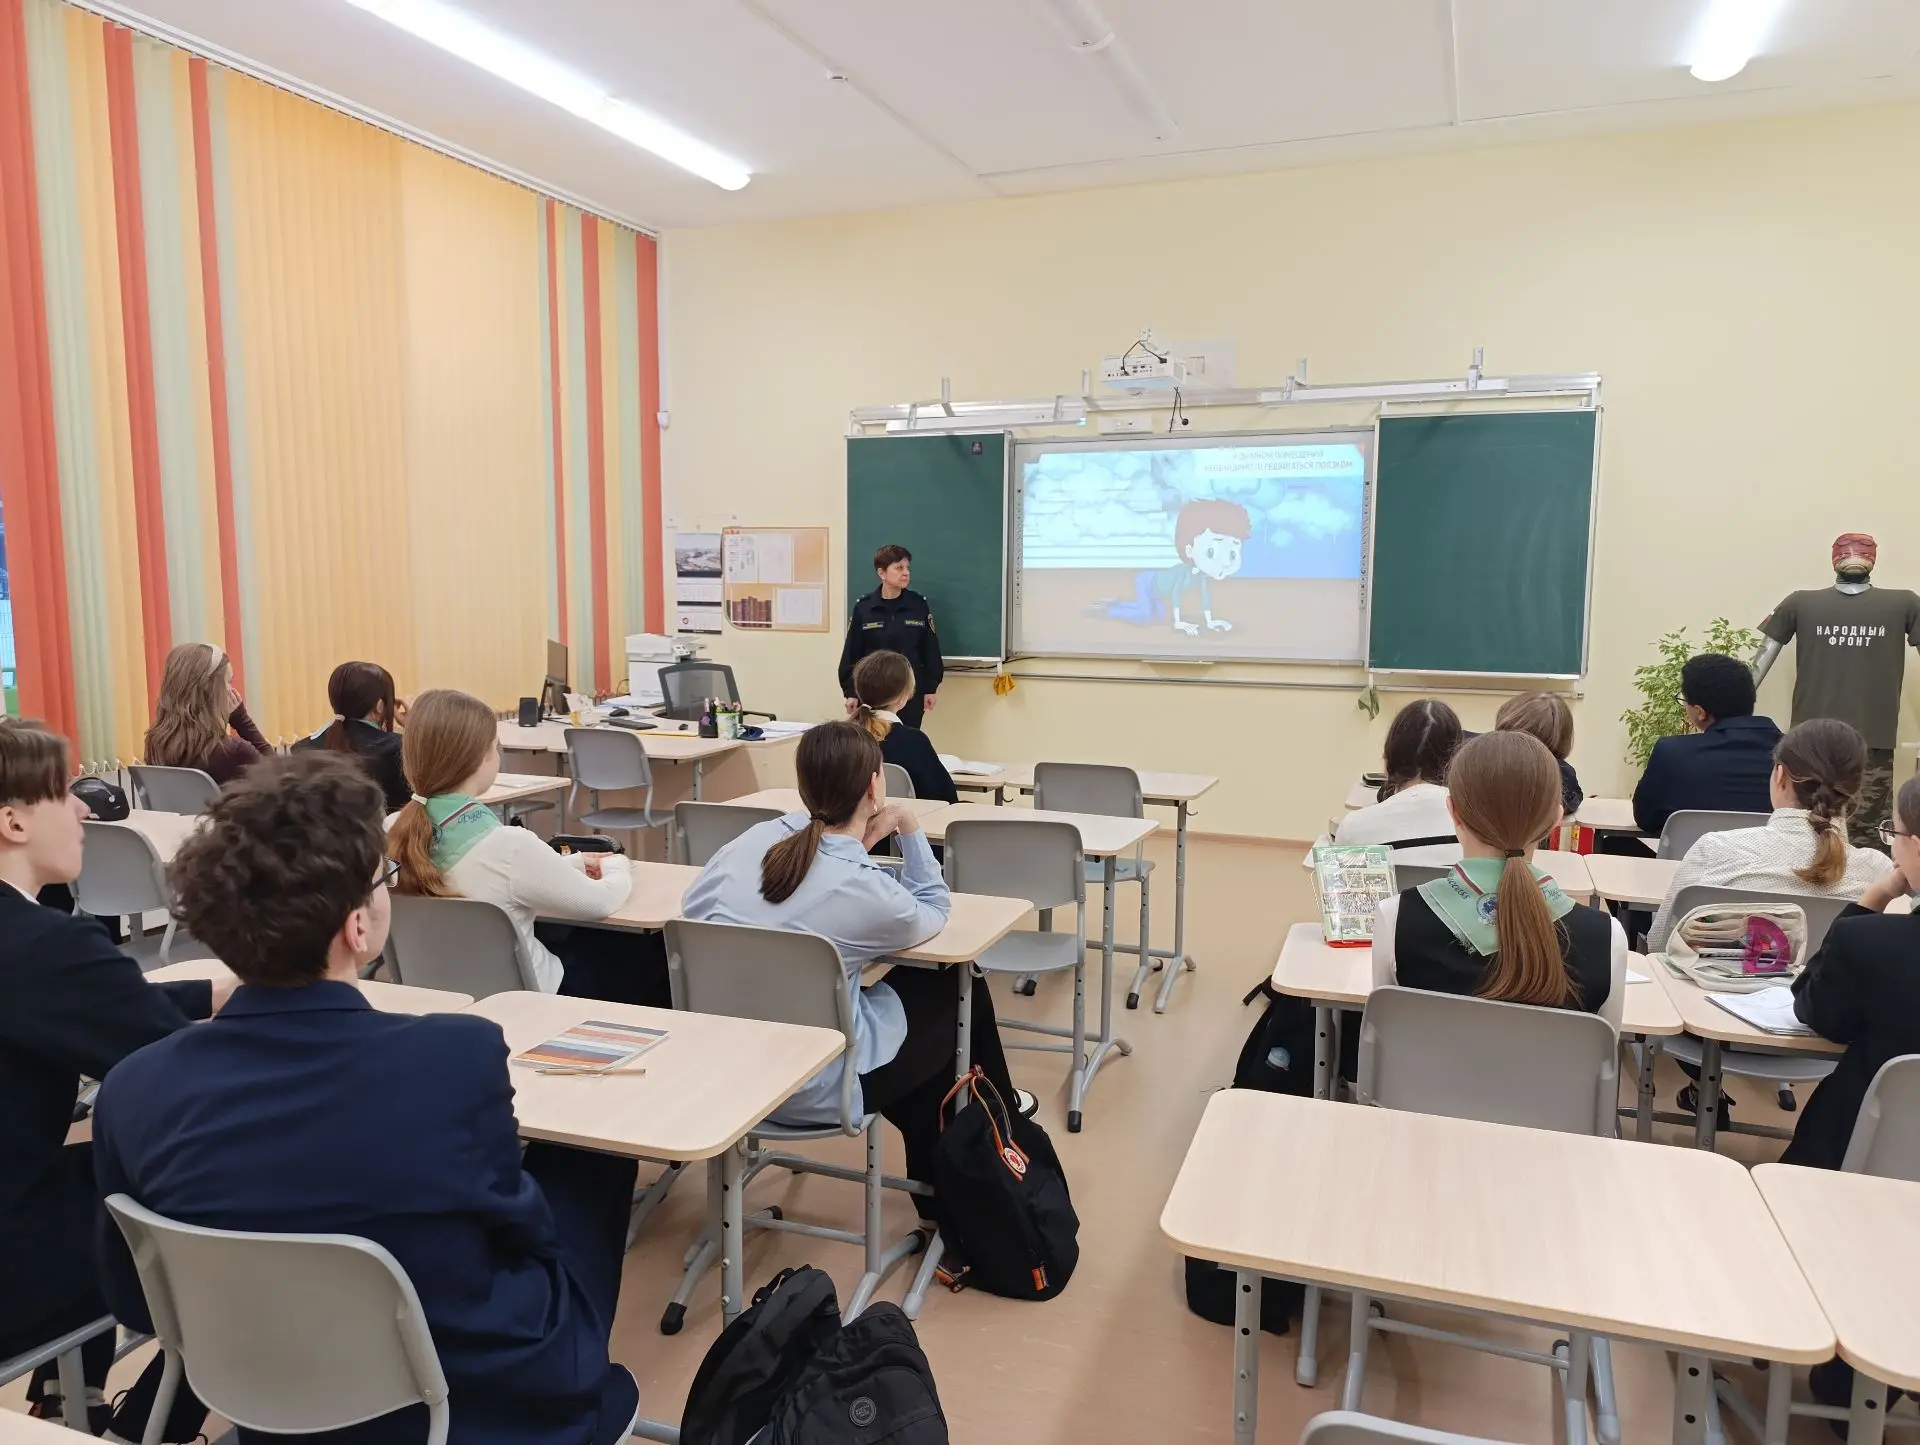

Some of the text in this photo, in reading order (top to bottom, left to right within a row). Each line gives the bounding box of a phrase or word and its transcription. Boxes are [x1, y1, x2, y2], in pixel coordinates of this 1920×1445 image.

[1315, 460, 1353, 470] ПОЛЗКОМ
[1816, 625, 1885, 636] НАРОДНЫЙ
[1828, 636, 1871, 646] ФРОНТ
